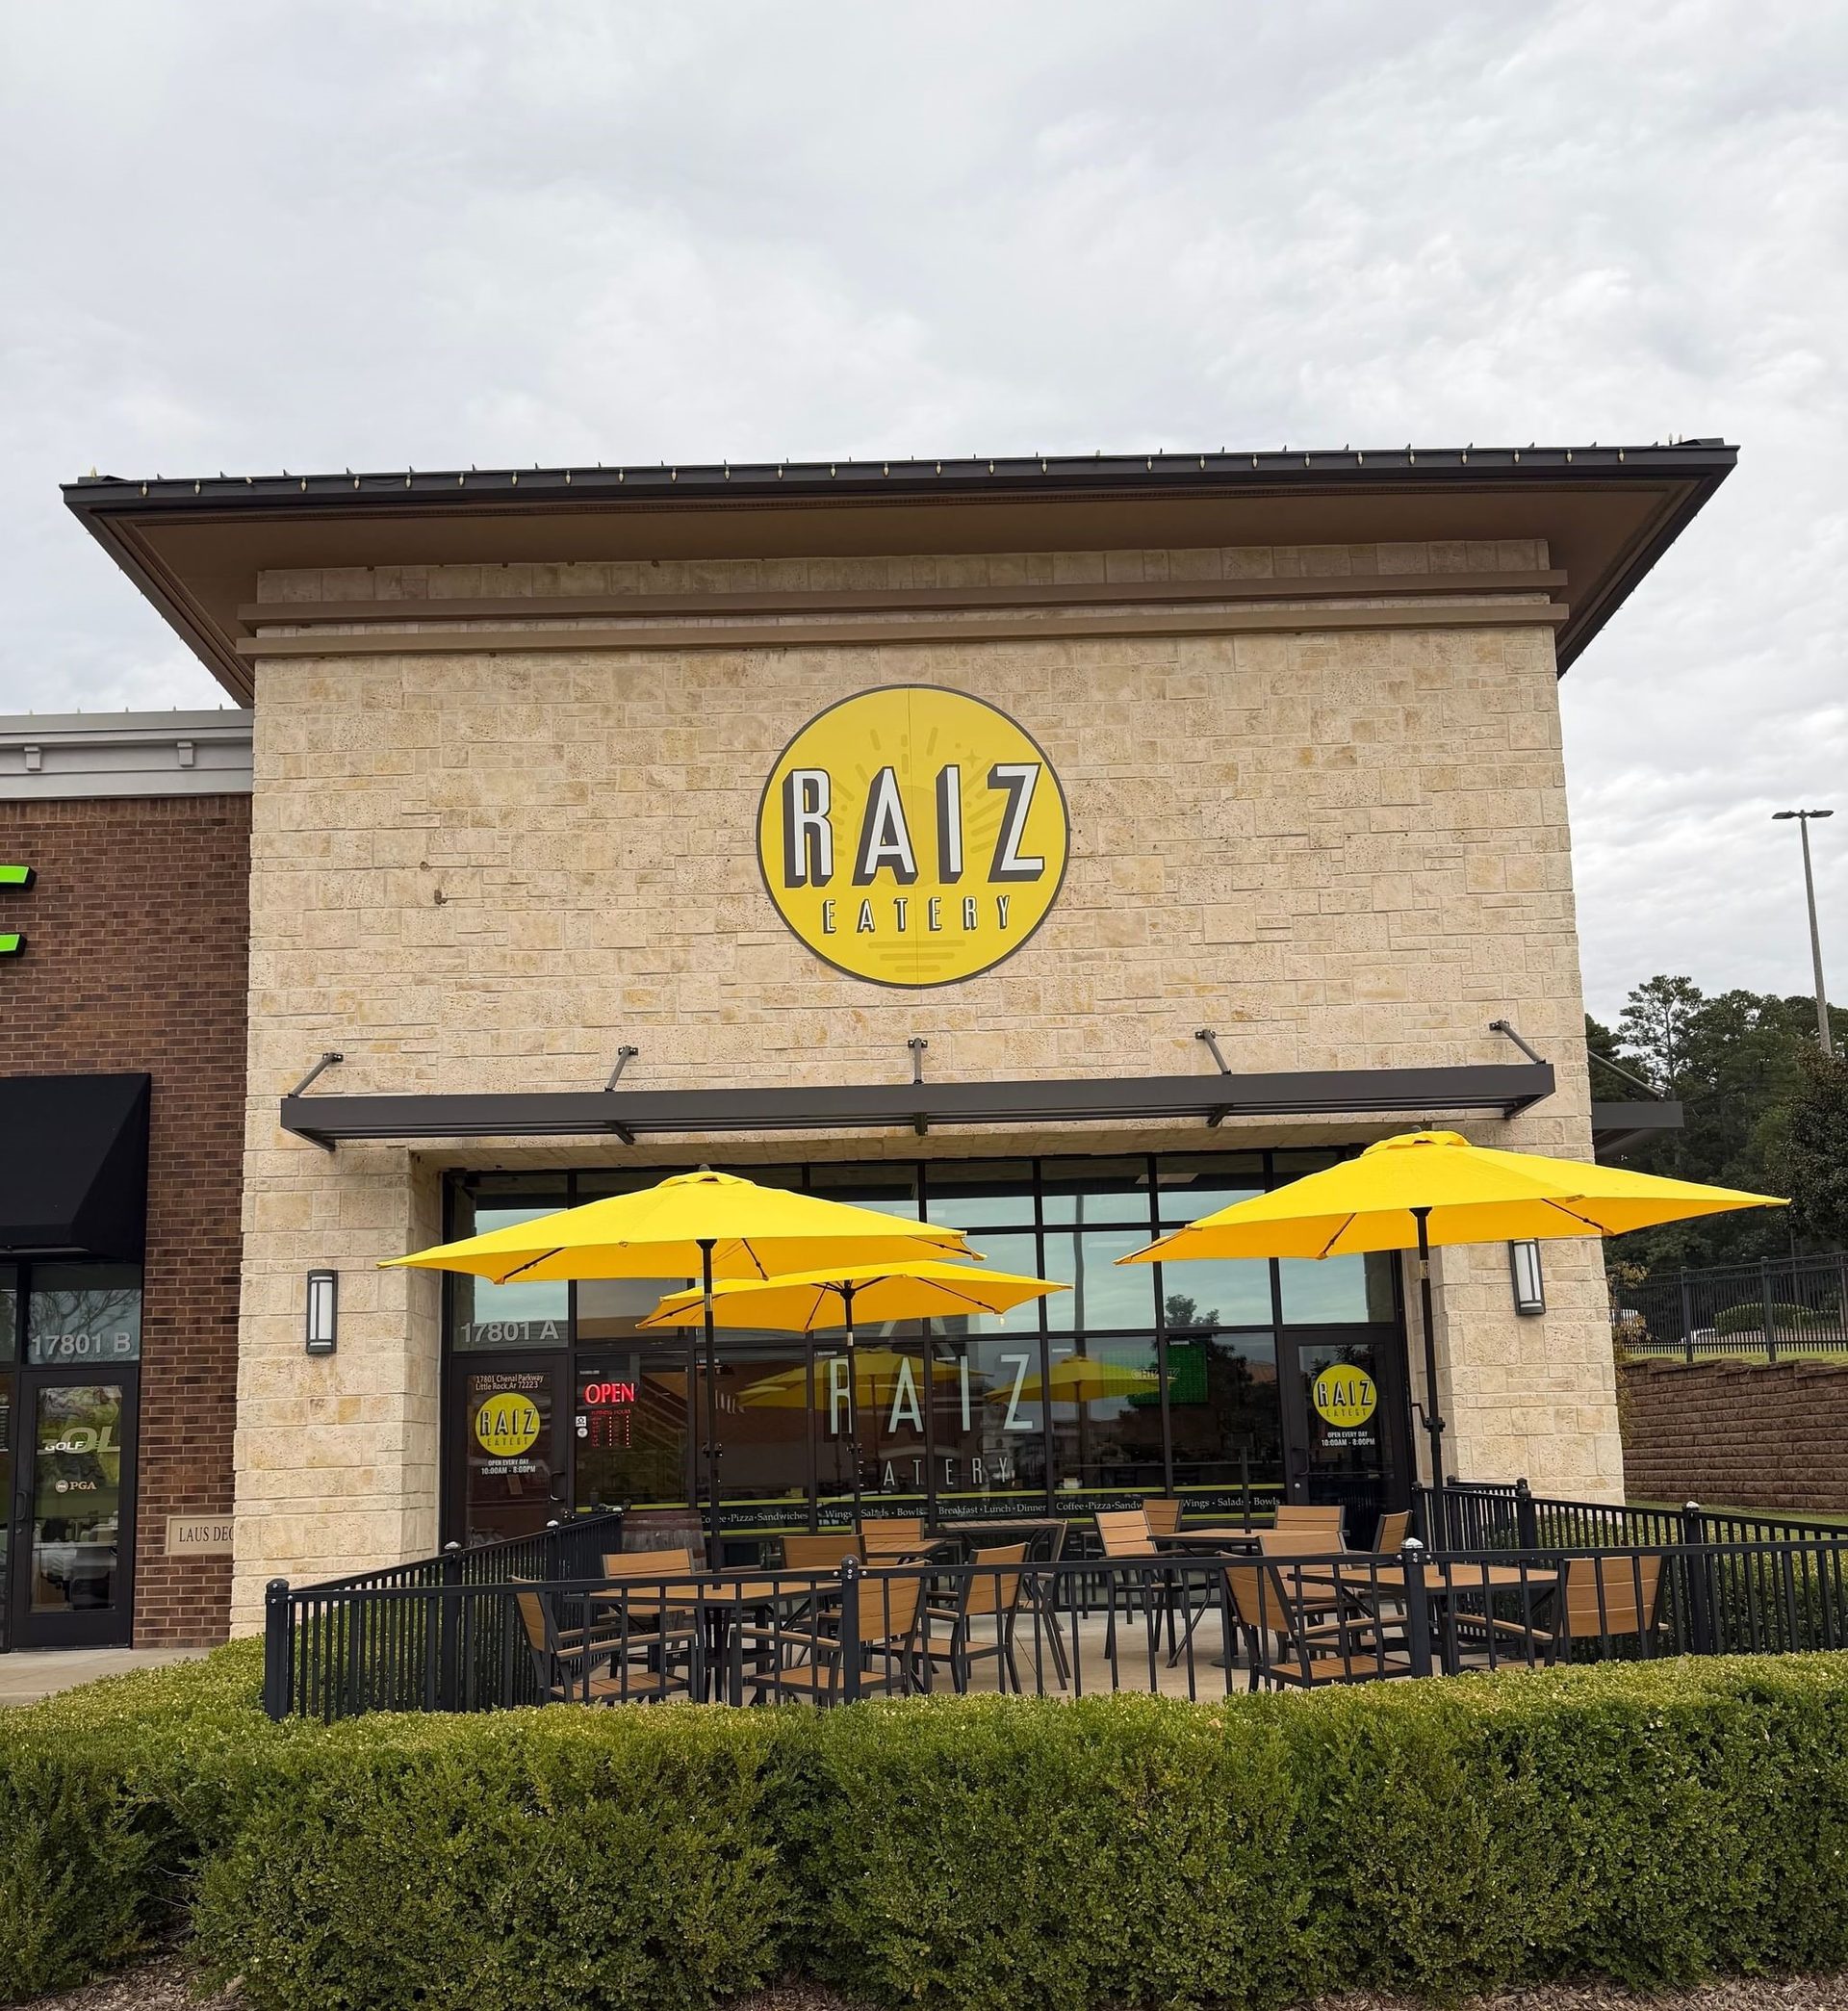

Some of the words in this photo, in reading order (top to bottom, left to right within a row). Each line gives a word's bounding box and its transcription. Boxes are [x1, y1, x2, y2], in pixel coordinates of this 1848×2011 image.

[782, 761, 1045, 889] RAIZ
[823, 894, 1011, 934] EATERY
[460, 1322, 530, 1343] 17801
[539, 1320, 559, 1340] A
[32, 1333, 101, 1355] 17801
[114, 1331, 131, 1354] B
[519, 1374, 544, 1383] Parkway
[584, 1382, 636, 1405] OPEN
[829, 1354, 1033, 1434] RAIZ
[1318, 1379, 1373, 1406] RAIZ
[479, 1408, 536, 1436] RAIZ
[44, 1440, 85, 1451] GOLF
[481, 1466, 508, 1475] 10:00AM
[69, 1481, 97, 1490] PGA
[1056, 1501, 1085, 1510] Coffee
[1088, 1501, 1112, 1510] Pizza
[1183, 1498, 1210, 1508] Wings
[1253, 1496, 1281, 1506] Bowls
[731, 1512, 755, 1522] Pizza
[757, 1510, 809, 1521] Sandwiches
[824, 1509, 853, 1520] Wings
[897, 1507, 926, 1516] Bowls
[938, 1505, 978, 1516] Breakfast
[984, 1504, 1012, 1513] Lunch
[1016, 1503, 1047, 1512] Dinner
[179, 1526, 210, 1542] LAUS
